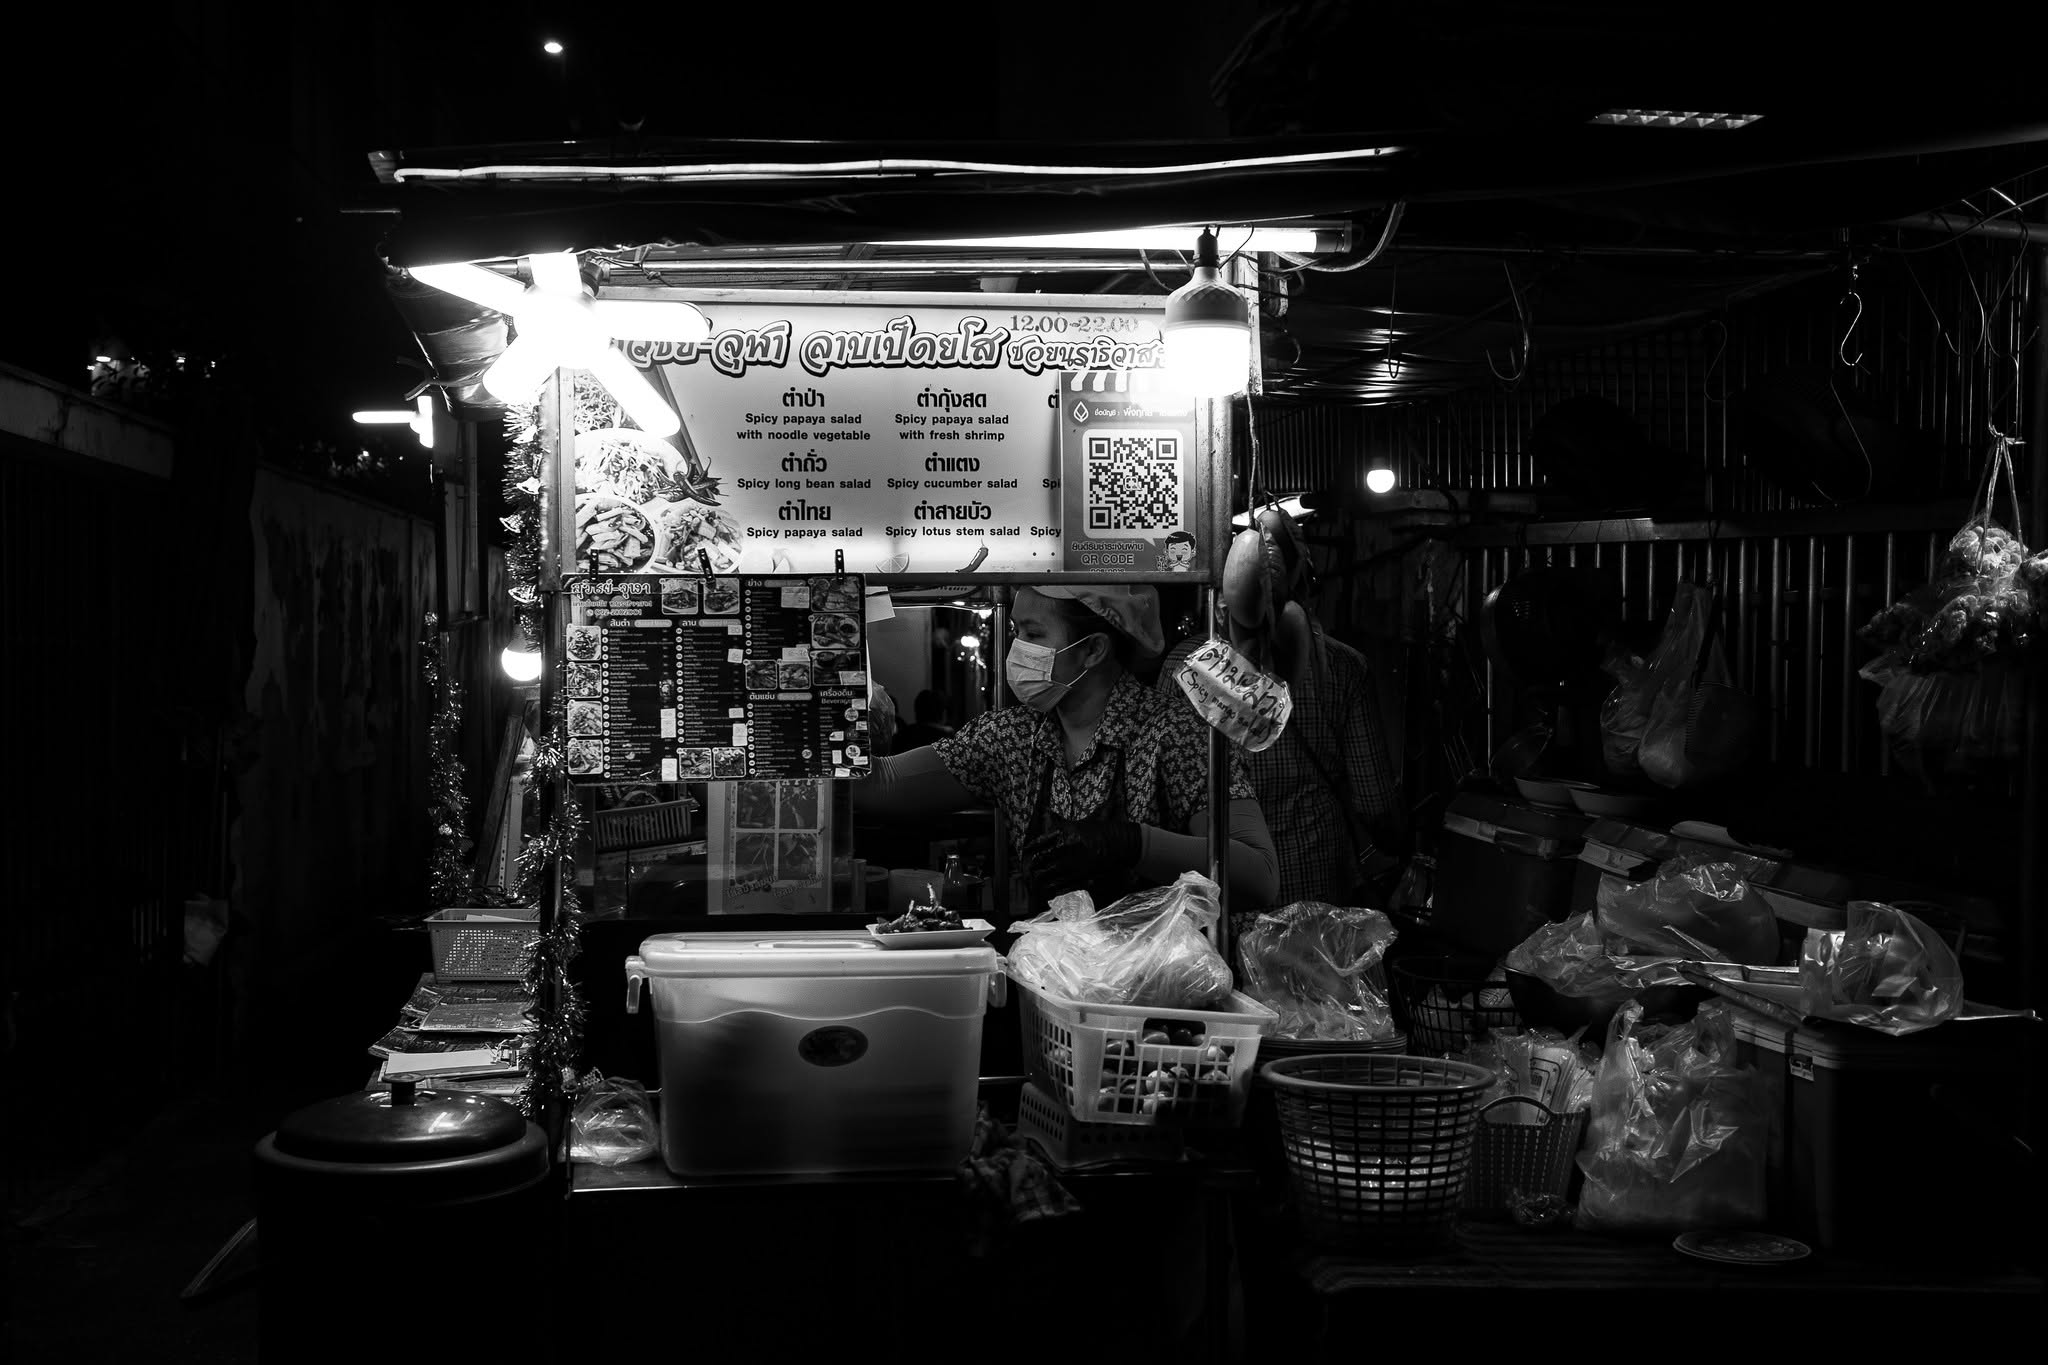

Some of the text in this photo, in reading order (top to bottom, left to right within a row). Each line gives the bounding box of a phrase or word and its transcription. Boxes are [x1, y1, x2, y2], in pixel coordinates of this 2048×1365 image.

[802, 317, 1006, 373] ลาบเป็ดยโส
[1008, 337, 1166, 372] ซอยนราธิวาส
[783, 387, 824, 407] ตำป่า
[917, 388, 986, 412] ตำกุ้งสด
[746, 413, 861, 425] Spicy papaya salad
[895, 414, 1008, 425] Spicy papaya salad
[737, 430, 870, 442] with noodle vegetable
[900, 430, 1004, 442] with fresh shrimp
[782, 449, 827, 472] ตำถั่ว
[925, 452, 980, 472] ตำแตง
[738, 478, 871, 490] Spicy long bean salad
[887, 478, 1017, 489] Spicy cucumber salad
[779, 499, 831, 520] ตำไทย
[914, 500, 991, 520] ตำสายบัว
[747, 527, 862, 538] Spicy papaya salad
[886, 526, 1020, 538] Spicy lotus stem salad
[1030, 526, 1061, 537] Spicy
[1081, 554, 1135, 565] QR CODE
